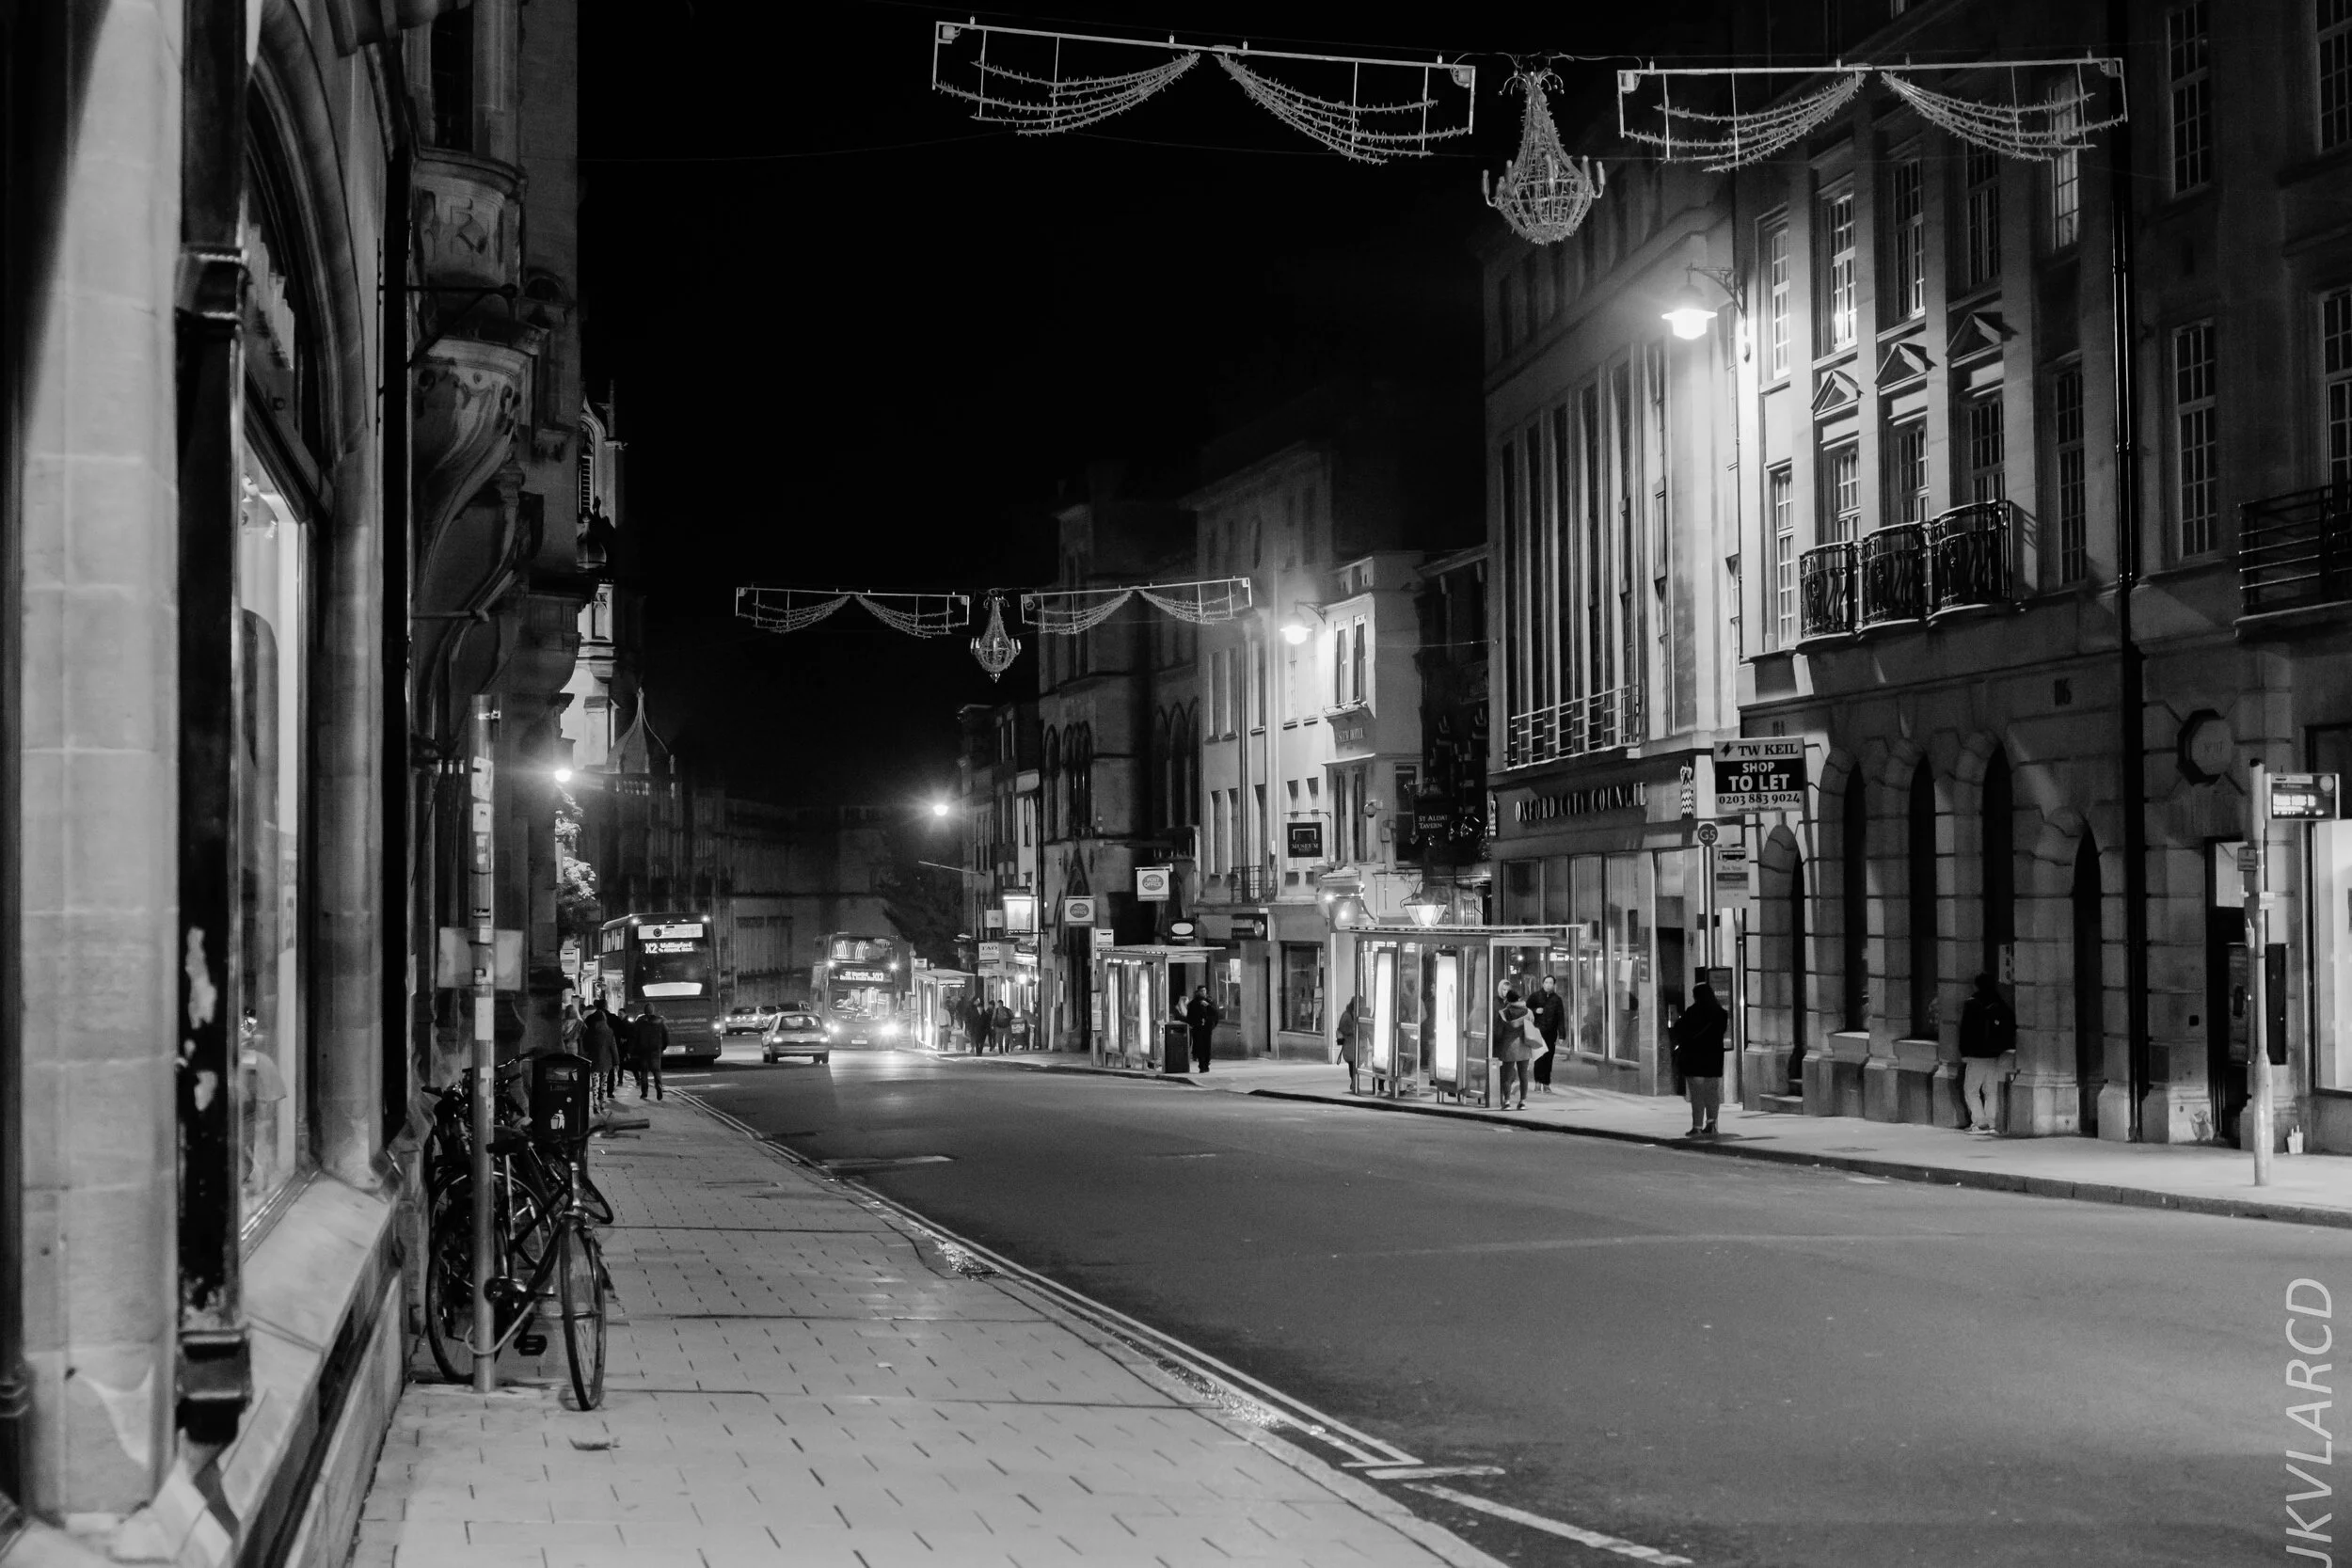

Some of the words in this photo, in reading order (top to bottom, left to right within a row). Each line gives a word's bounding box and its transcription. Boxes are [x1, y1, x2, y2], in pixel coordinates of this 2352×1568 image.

[1738, 745, 1761, 756] TW
[1764, 743, 1799, 755] KEIL
[1742, 762, 1775, 773] SHOP
[1728, 775, 1753, 791] TO
[1758, 773, 1789, 790] LET
[1515, 797, 1555, 822] OXFORD
[1560, 791, 1586, 816] CITY
[1591, 782, 1646, 813] COUNCIL
[1719, 795, 1745, 805] 0203
[1748, 793, 1769, 805] 883
[1772, 793, 1800, 804] 9024
